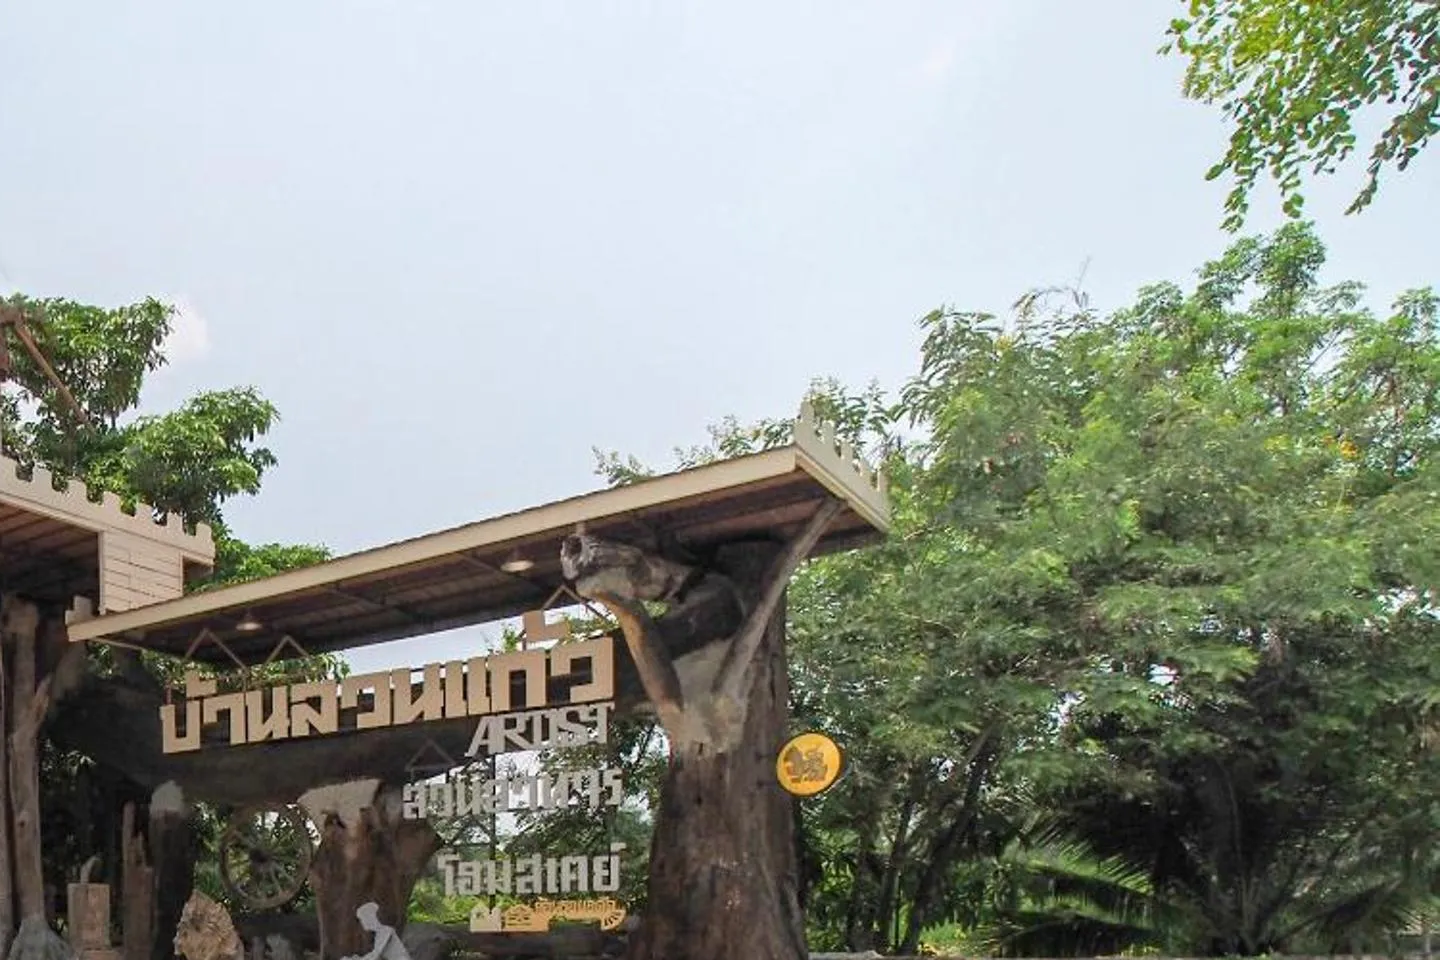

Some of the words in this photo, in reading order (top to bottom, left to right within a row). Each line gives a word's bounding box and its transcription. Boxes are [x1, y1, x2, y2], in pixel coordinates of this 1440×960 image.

[160, 610, 615, 754] บ้านสวนแก้ว
